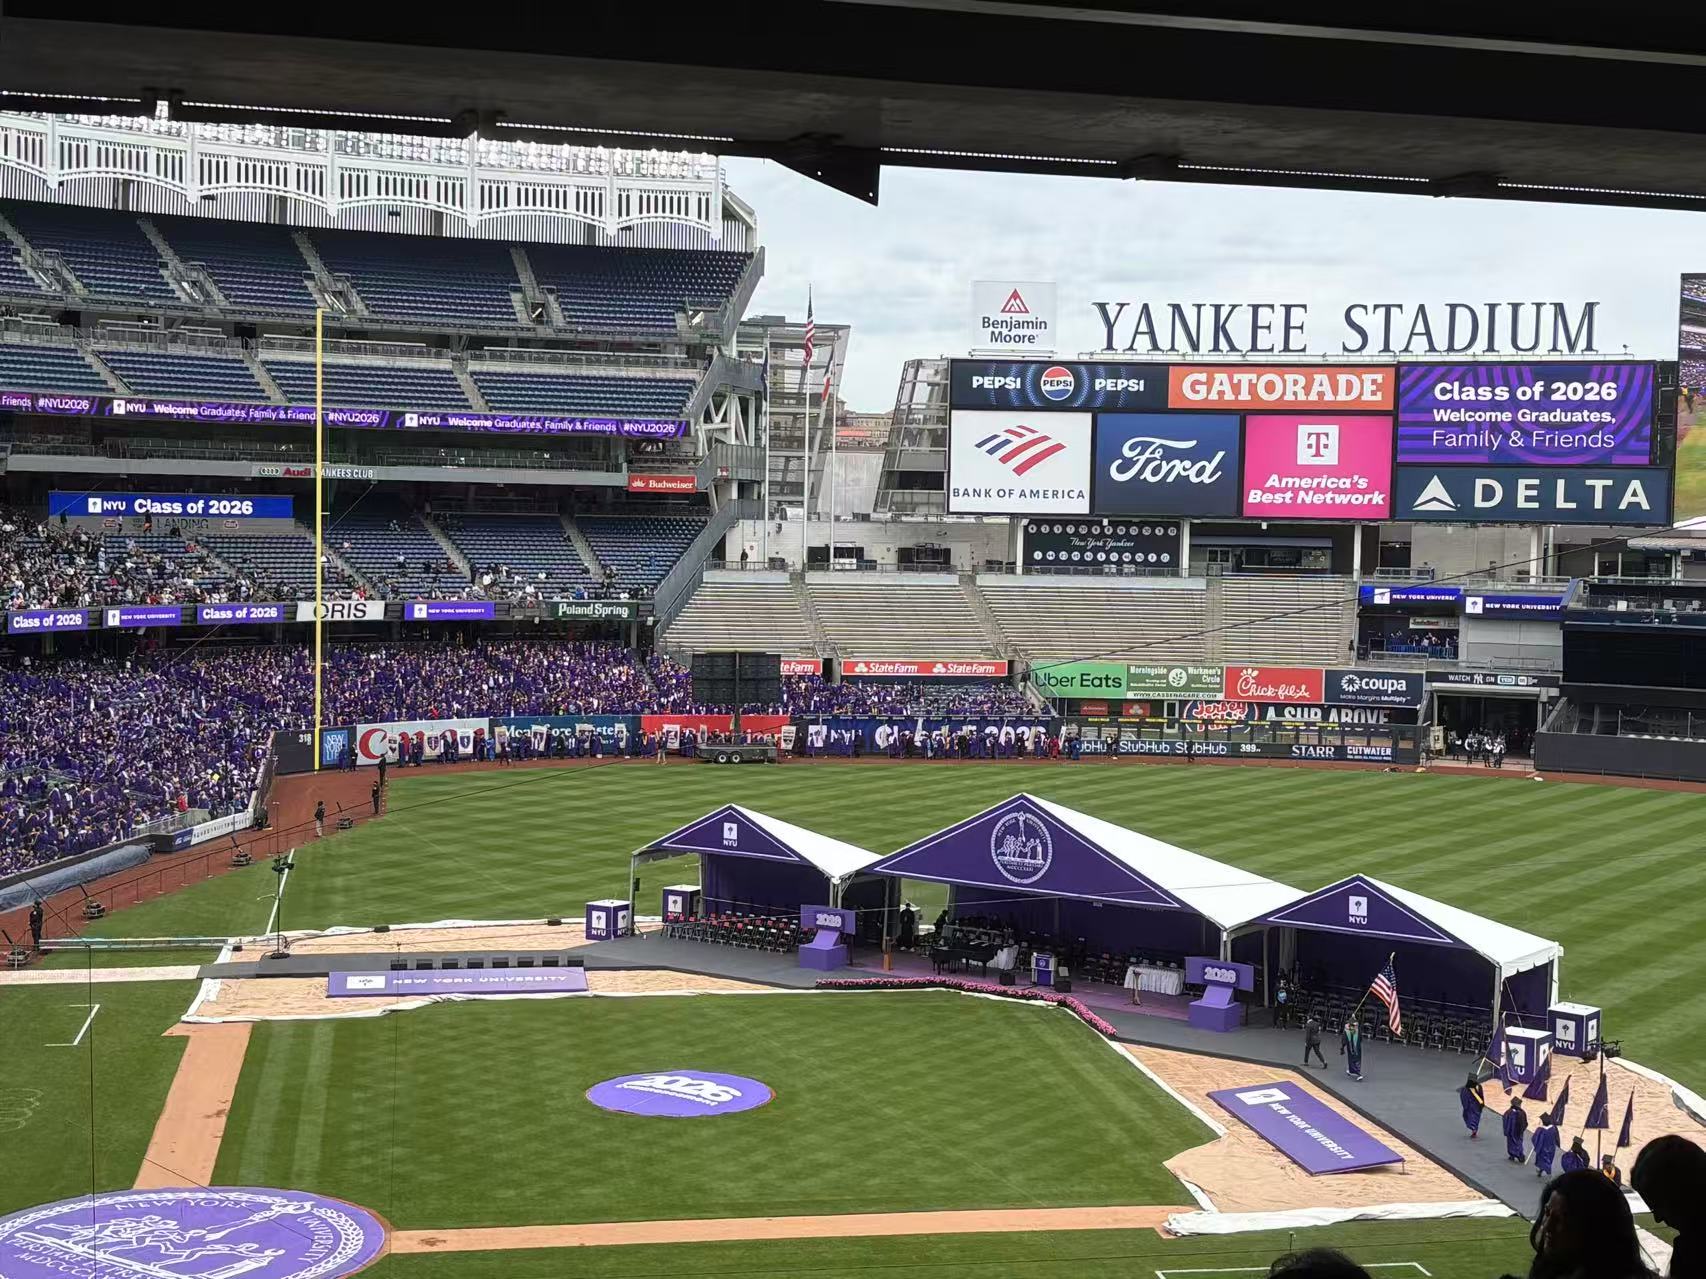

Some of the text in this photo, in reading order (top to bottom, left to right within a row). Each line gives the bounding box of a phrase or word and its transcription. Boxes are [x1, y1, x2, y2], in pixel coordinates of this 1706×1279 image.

[982, 317, 1047, 332] Benjamin
[1092, 302, 1601, 354] YANKEE STADIUM
[990, 331, 1036, 344] Moore
[972, 376, 1021, 389] PEPSI
[1043, 379, 1072, 388] PEPSI
[1095, 378, 1144, 392] PEPSI
[1181, 372, 1383, 401] GATORADE
[1434, 381, 1617, 401] Class of 2026
[39, 399, 90, 411] #NYU2026
[127, 404, 147, 412] NYU
[154, 404, 198, 415] Welcome
[249, 408, 277, 420] Family
[328, 413, 380, 424] #NYU2026
[1433, 408, 1616, 424] Welcome Graduates,
[420, 417, 440, 426] NYU
[448, 417, 493, 427] Welcome
[545, 421, 573, 433] Family
[583, 422, 617, 433] Friends
[623, 424, 676, 435] #NYU2026
[1432, 430, 1615, 453] Family & Friends
[1109, 437, 1226, 484] Ford
[282, 468, 311, 477] Audi
[353, 469, 374, 479] CLUB
[649, 479, 694, 490] Budweiser
[1265, 474, 1369, 489] America’s
[953, 488, 1085, 500] BANK OF AMERICA
[1248, 490, 1385, 505] Best Network
[1473, 479, 1651, 510] DELTA
[103, 498, 253, 515] NYU Class of 2026
[203, 607, 278, 620] Class of 2026
[558, 603, 628, 617] Poland Spring
[13, 614, 82, 628] Class of 2026
[1035, 672, 1076, 688] Uber
[1079, 672, 1122, 689] Eats
[1361, 677, 1406, 693] coupa
[1448, 674, 1470, 682] WATCH
[1237, 675, 1310, 699] Chick-fil-A
[1119, 740, 1170, 753] StubHub
[1240, 744, 1256, 752] 399
[1291, 744, 1335, 757] STARR
[1346, 746, 1391, 755] CUTWATER
[723, 839, 738, 847] NYU
[1348, 916, 1367, 925] NYU
[591, 929, 607, 937] NYU
[1555, 1040, 1575, 1050] NYU
[1268, 1102, 1355, 1160] NEW YORK UNIVERSITY
[115, 1200, 176, 1211] NEW
[296, 1215, 334, 1263] UNIVERSITY
